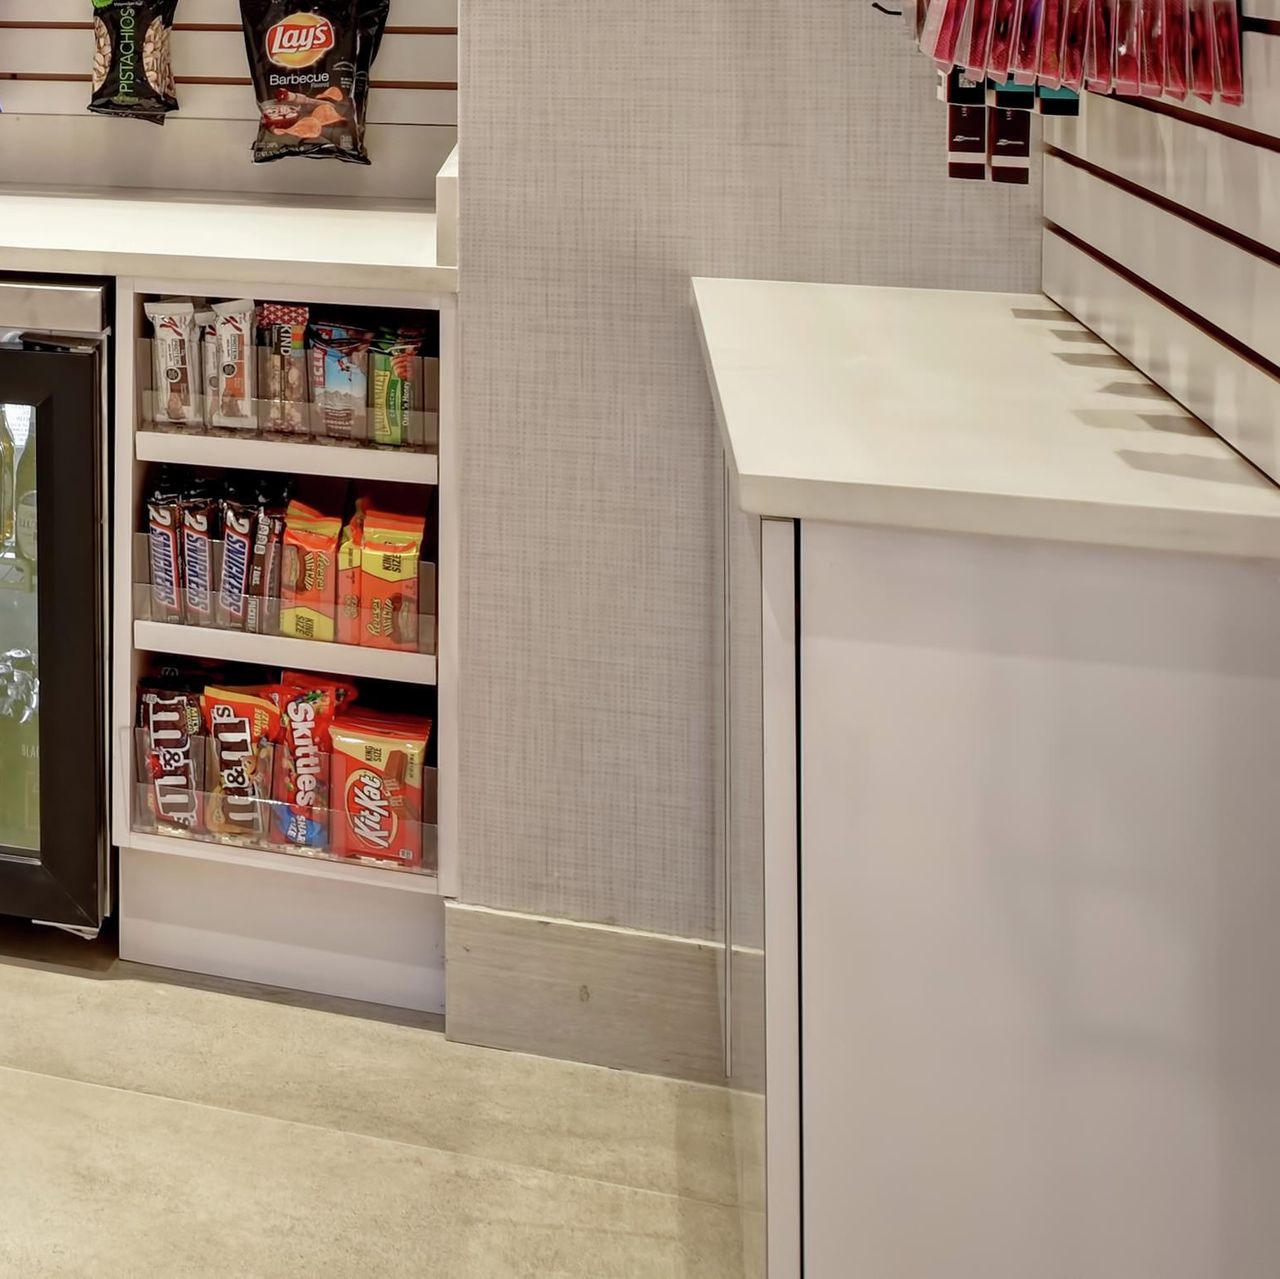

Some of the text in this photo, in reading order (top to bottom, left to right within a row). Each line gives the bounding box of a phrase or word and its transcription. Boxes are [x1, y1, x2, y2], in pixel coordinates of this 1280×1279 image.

[272, 22, 328, 53] Lay's
[120, 6, 135, 93] PISTACHIOS
[269, 72, 329, 86] Barbecue
[280, 324, 292, 356] KIND
[148, 504, 171, 526] 2
[185, 510, 208, 532] 2
[226, 510, 250, 534] 2
[392, 554, 402, 573] SIZE
[287, 701, 320, 807] Skittles
[365, 745, 374, 761] KING
[373, 747, 382, 762] SIZE
